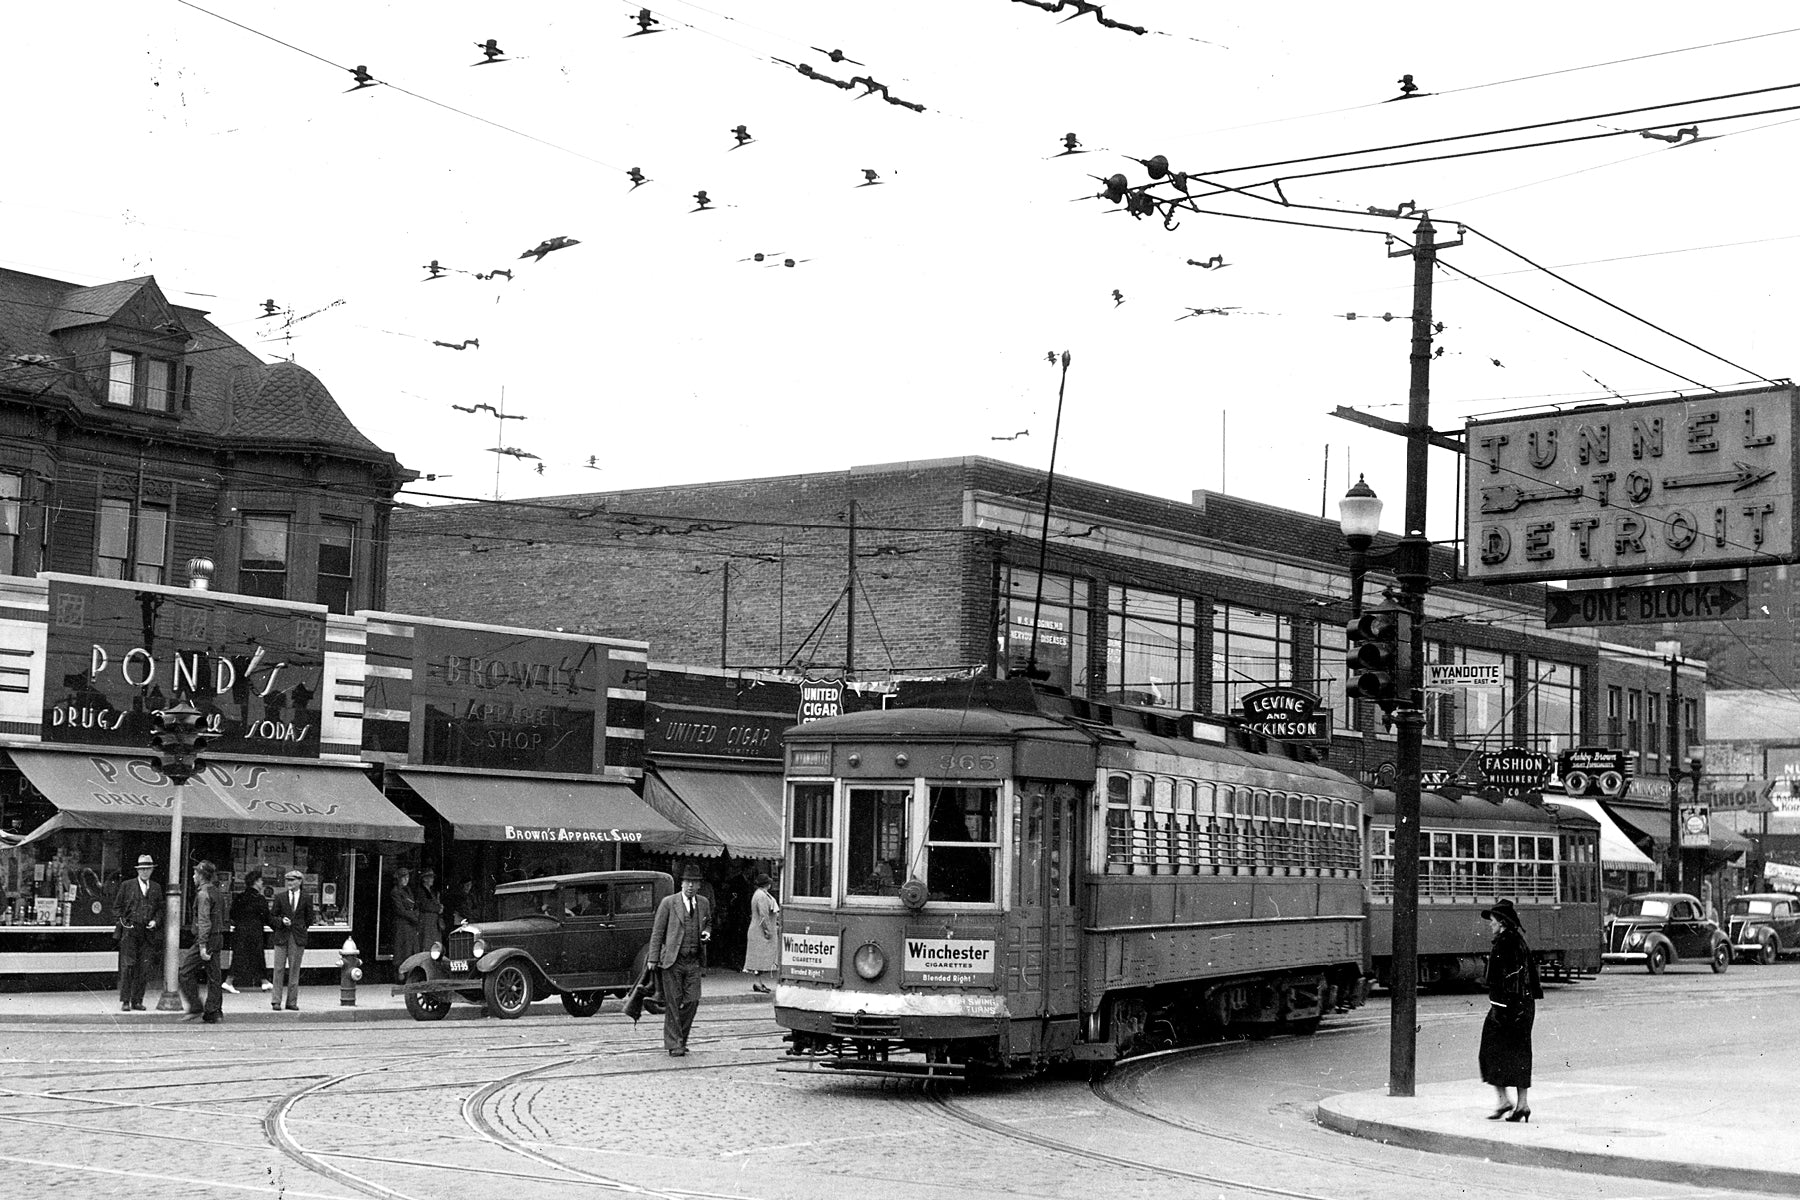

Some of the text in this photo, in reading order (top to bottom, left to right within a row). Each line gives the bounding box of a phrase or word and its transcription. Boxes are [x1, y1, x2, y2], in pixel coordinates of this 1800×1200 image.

[1480, 406, 1776, 474] TUNNEL
[1592, 468, 1652, 507] TO
[1480, 502, 1776, 565] DETROIT
[1581, 585, 1713, 622] ONE BLOCK
[1010, 630, 1033, 641] NERVOU
[91, 645, 286, 698] POND'S
[1431, 666, 1499, 679] WYANDOTTE
[804, 687, 839, 701] UNITED
[803, 703, 838, 716] CIGAR
[1253, 695, 1305, 712] LEVINE
[53, 705, 129, 730] DRUGS
[244, 720, 310, 742] SODAS
[487, 729, 542, 751] SHOP
[665, 722, 718, 744] UNITED
[727, 724, 771, 747] CIGAR
[939, 755, 997, 771] 365
[1485, 758, 1543, 770] FASHION
[1490, 775, 1538, 783] MILLINERY
[1508, 788, 1519, 796] CO
[93, 792, 341, 816] DRUGS SODAS
[505, 825, 642, 843] BROWN'S APPAREL SHOP
[784, 936, 836, 956] Winchester
[908, 942, 990, 961] Winchester
[792, 956, 822, 964] CIGARETTES
[922, 974, 951, 983] Blended
[967, 1006, 996, 1015] TURNS
